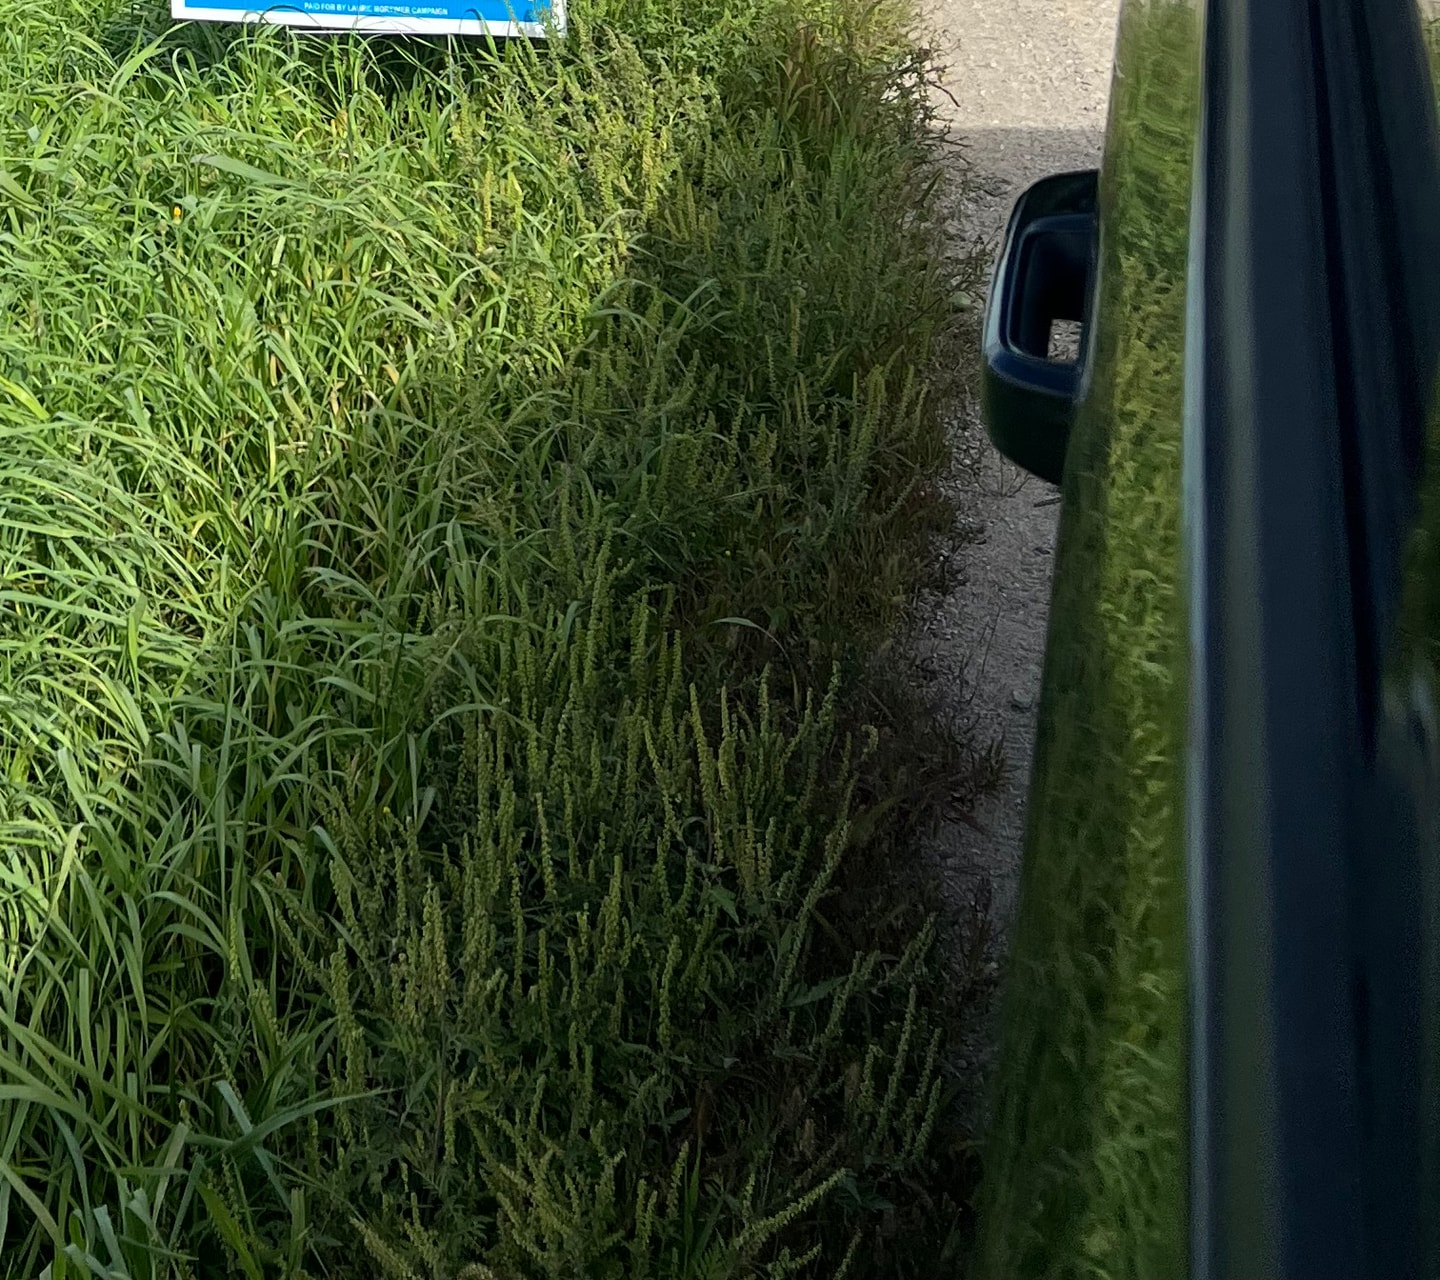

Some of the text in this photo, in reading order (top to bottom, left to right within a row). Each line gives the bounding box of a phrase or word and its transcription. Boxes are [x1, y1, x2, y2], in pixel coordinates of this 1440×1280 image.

[304, 2, 320, 10] PAID
[321, 3, 336, 11] FOR
[336, 3, 347, 11] BY
